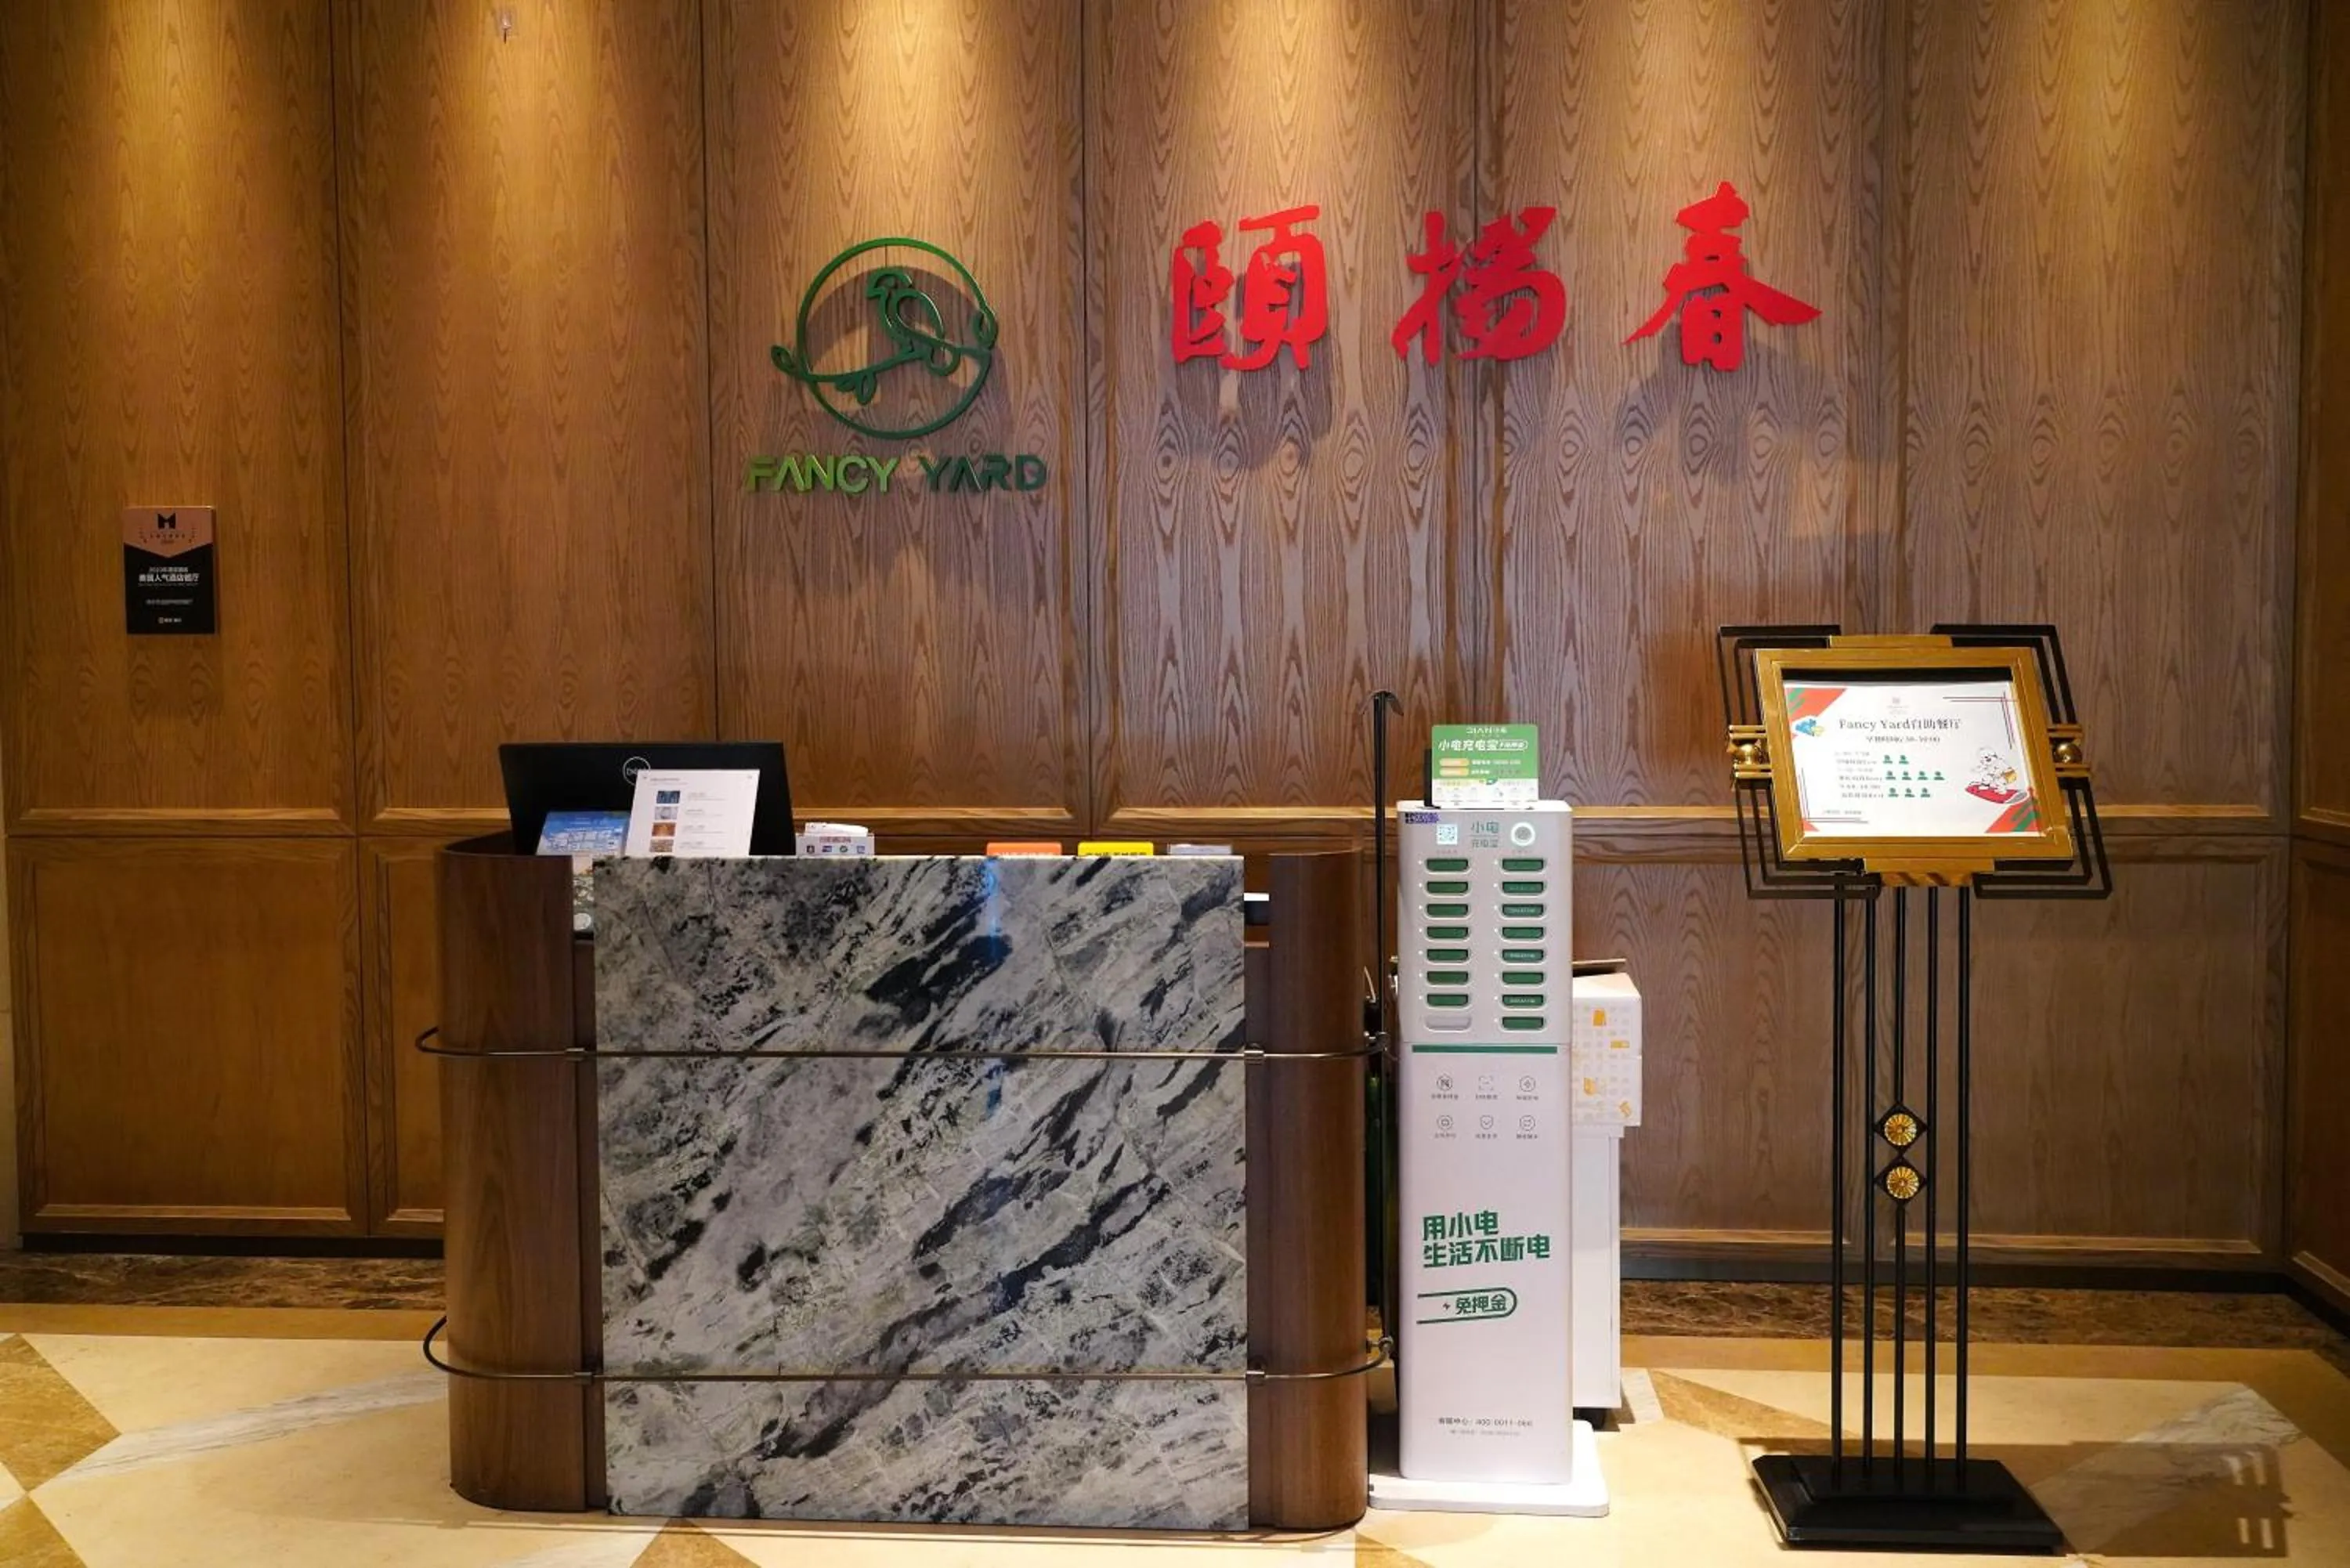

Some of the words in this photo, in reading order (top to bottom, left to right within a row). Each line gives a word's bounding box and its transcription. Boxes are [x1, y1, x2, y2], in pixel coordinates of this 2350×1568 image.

[747, 453, 898, 493] FANCY
[918, 453, 1048, 492] YARD
[1838, 717, 1877, 732] Fancy
[1423, 1210, 1499, 1241] 用小电
[1423, 1234, 1550, 1269] 生活不断电
[1455, 1293, 1507, 1315] 免押金
